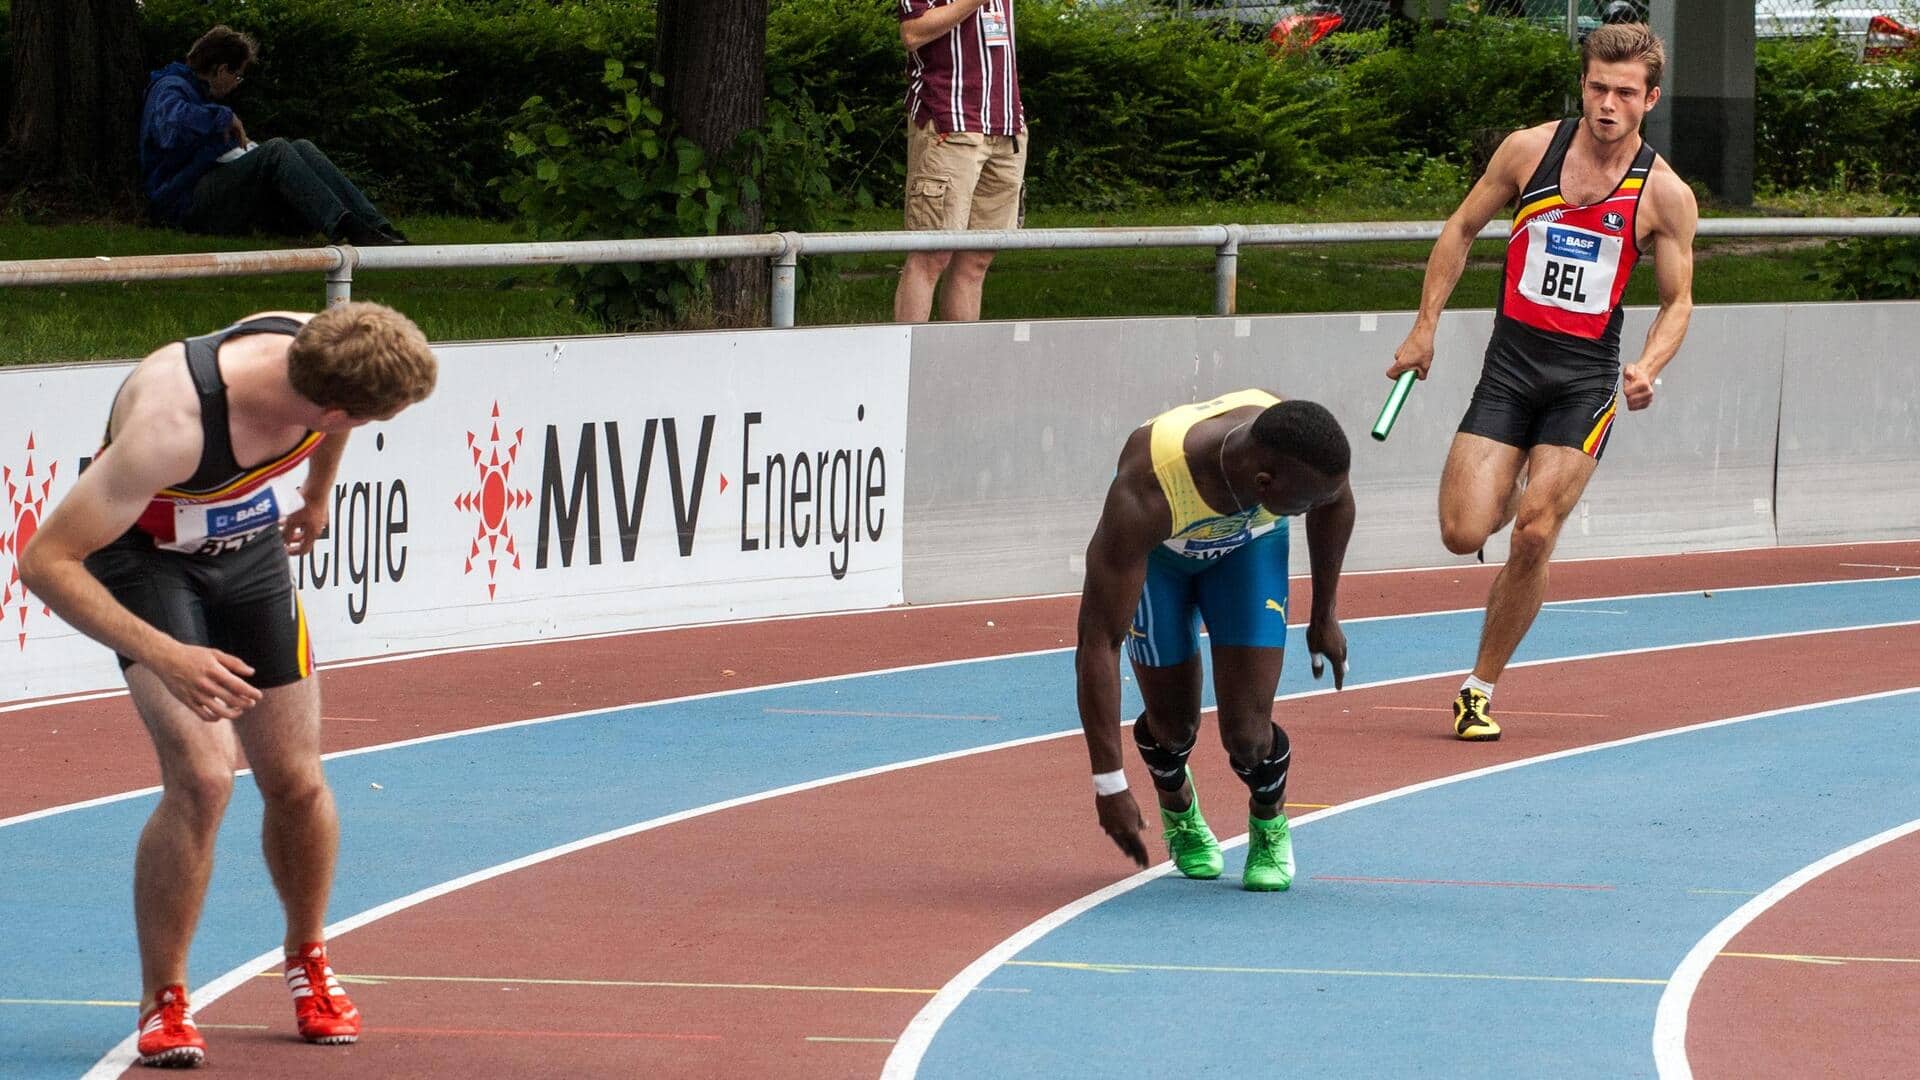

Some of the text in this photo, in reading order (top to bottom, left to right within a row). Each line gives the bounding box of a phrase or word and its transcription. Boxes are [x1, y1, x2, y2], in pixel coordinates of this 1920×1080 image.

[1566, 235, 1595, 249] BASF
[1541, 260, 1587, 303] BEL
[236, 498, 272, 522] BASF
[535, 404, 886, 580] MVV Energie
[298, 432, 408, 624] ergie
